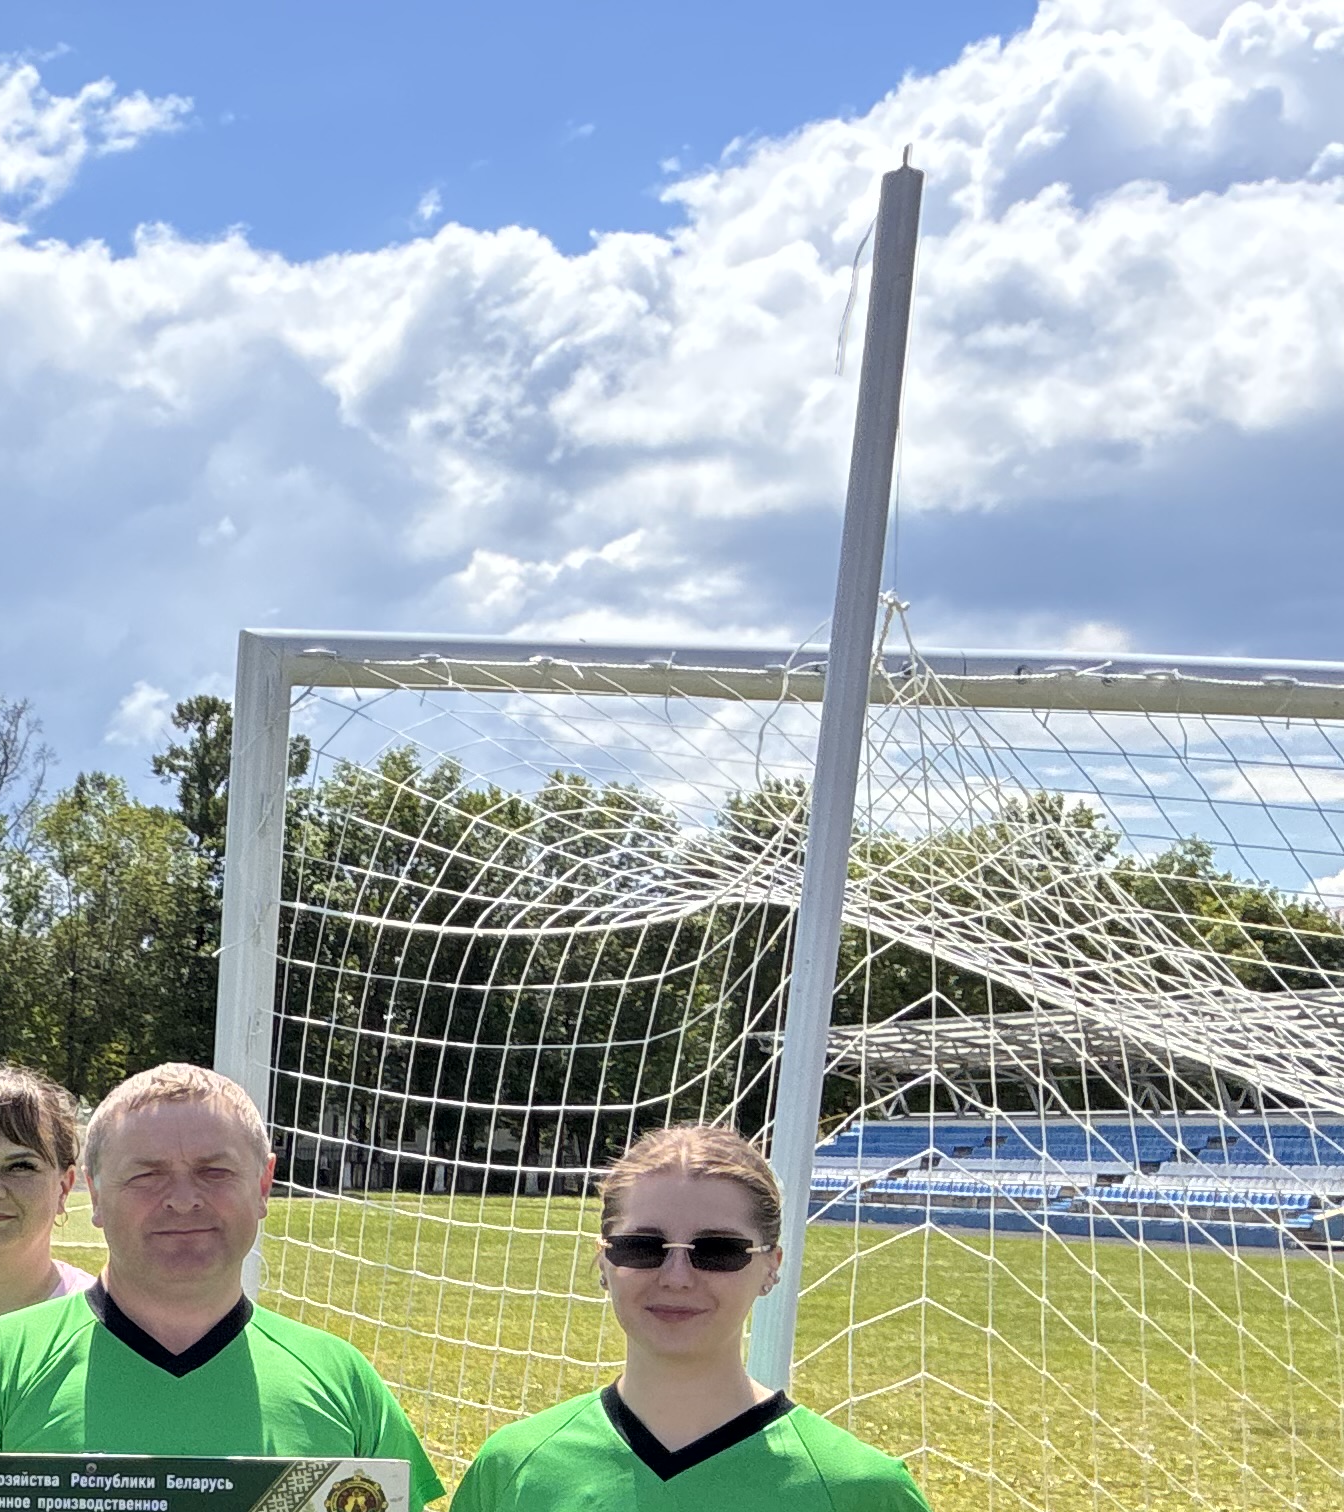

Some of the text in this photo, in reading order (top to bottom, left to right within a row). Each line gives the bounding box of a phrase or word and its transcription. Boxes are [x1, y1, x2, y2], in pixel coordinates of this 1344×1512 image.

[70, 1472, 155, 1491] Республики
[166, 1474, 233, 1493] Беларусь
[37, 1497, 168, 1512] производственное
